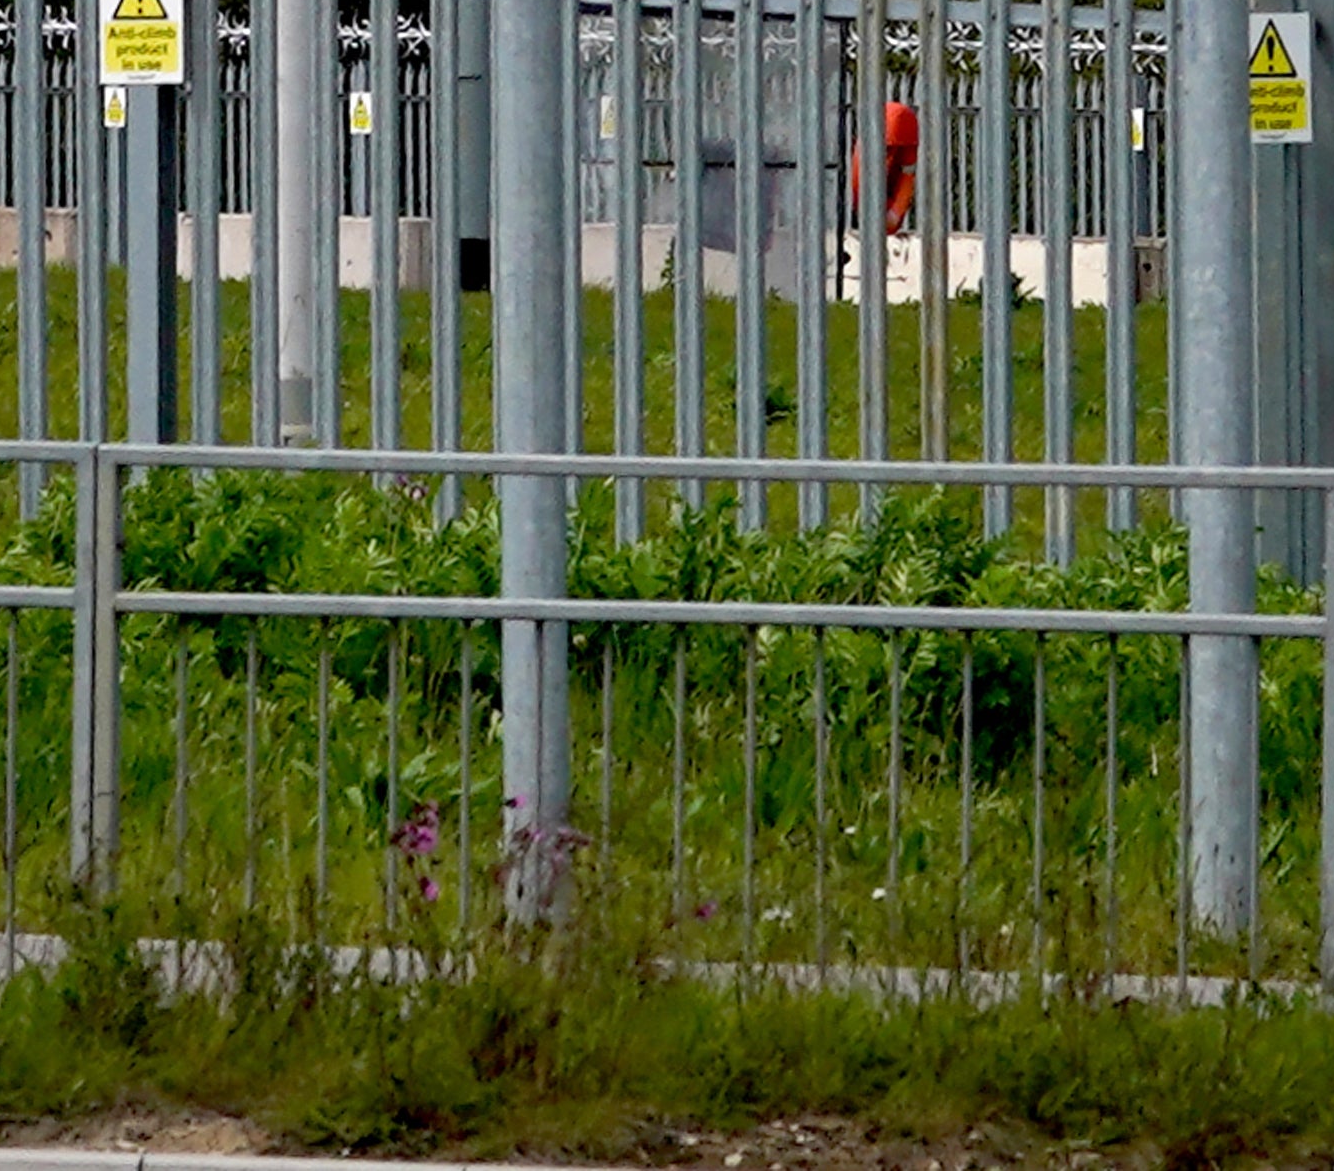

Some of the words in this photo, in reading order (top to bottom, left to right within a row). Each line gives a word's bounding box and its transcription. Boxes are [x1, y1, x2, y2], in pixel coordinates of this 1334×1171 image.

[116, 43, 168, 58] product
[121, 58, 134, 71] in
[137, 60, 162, 71] use
